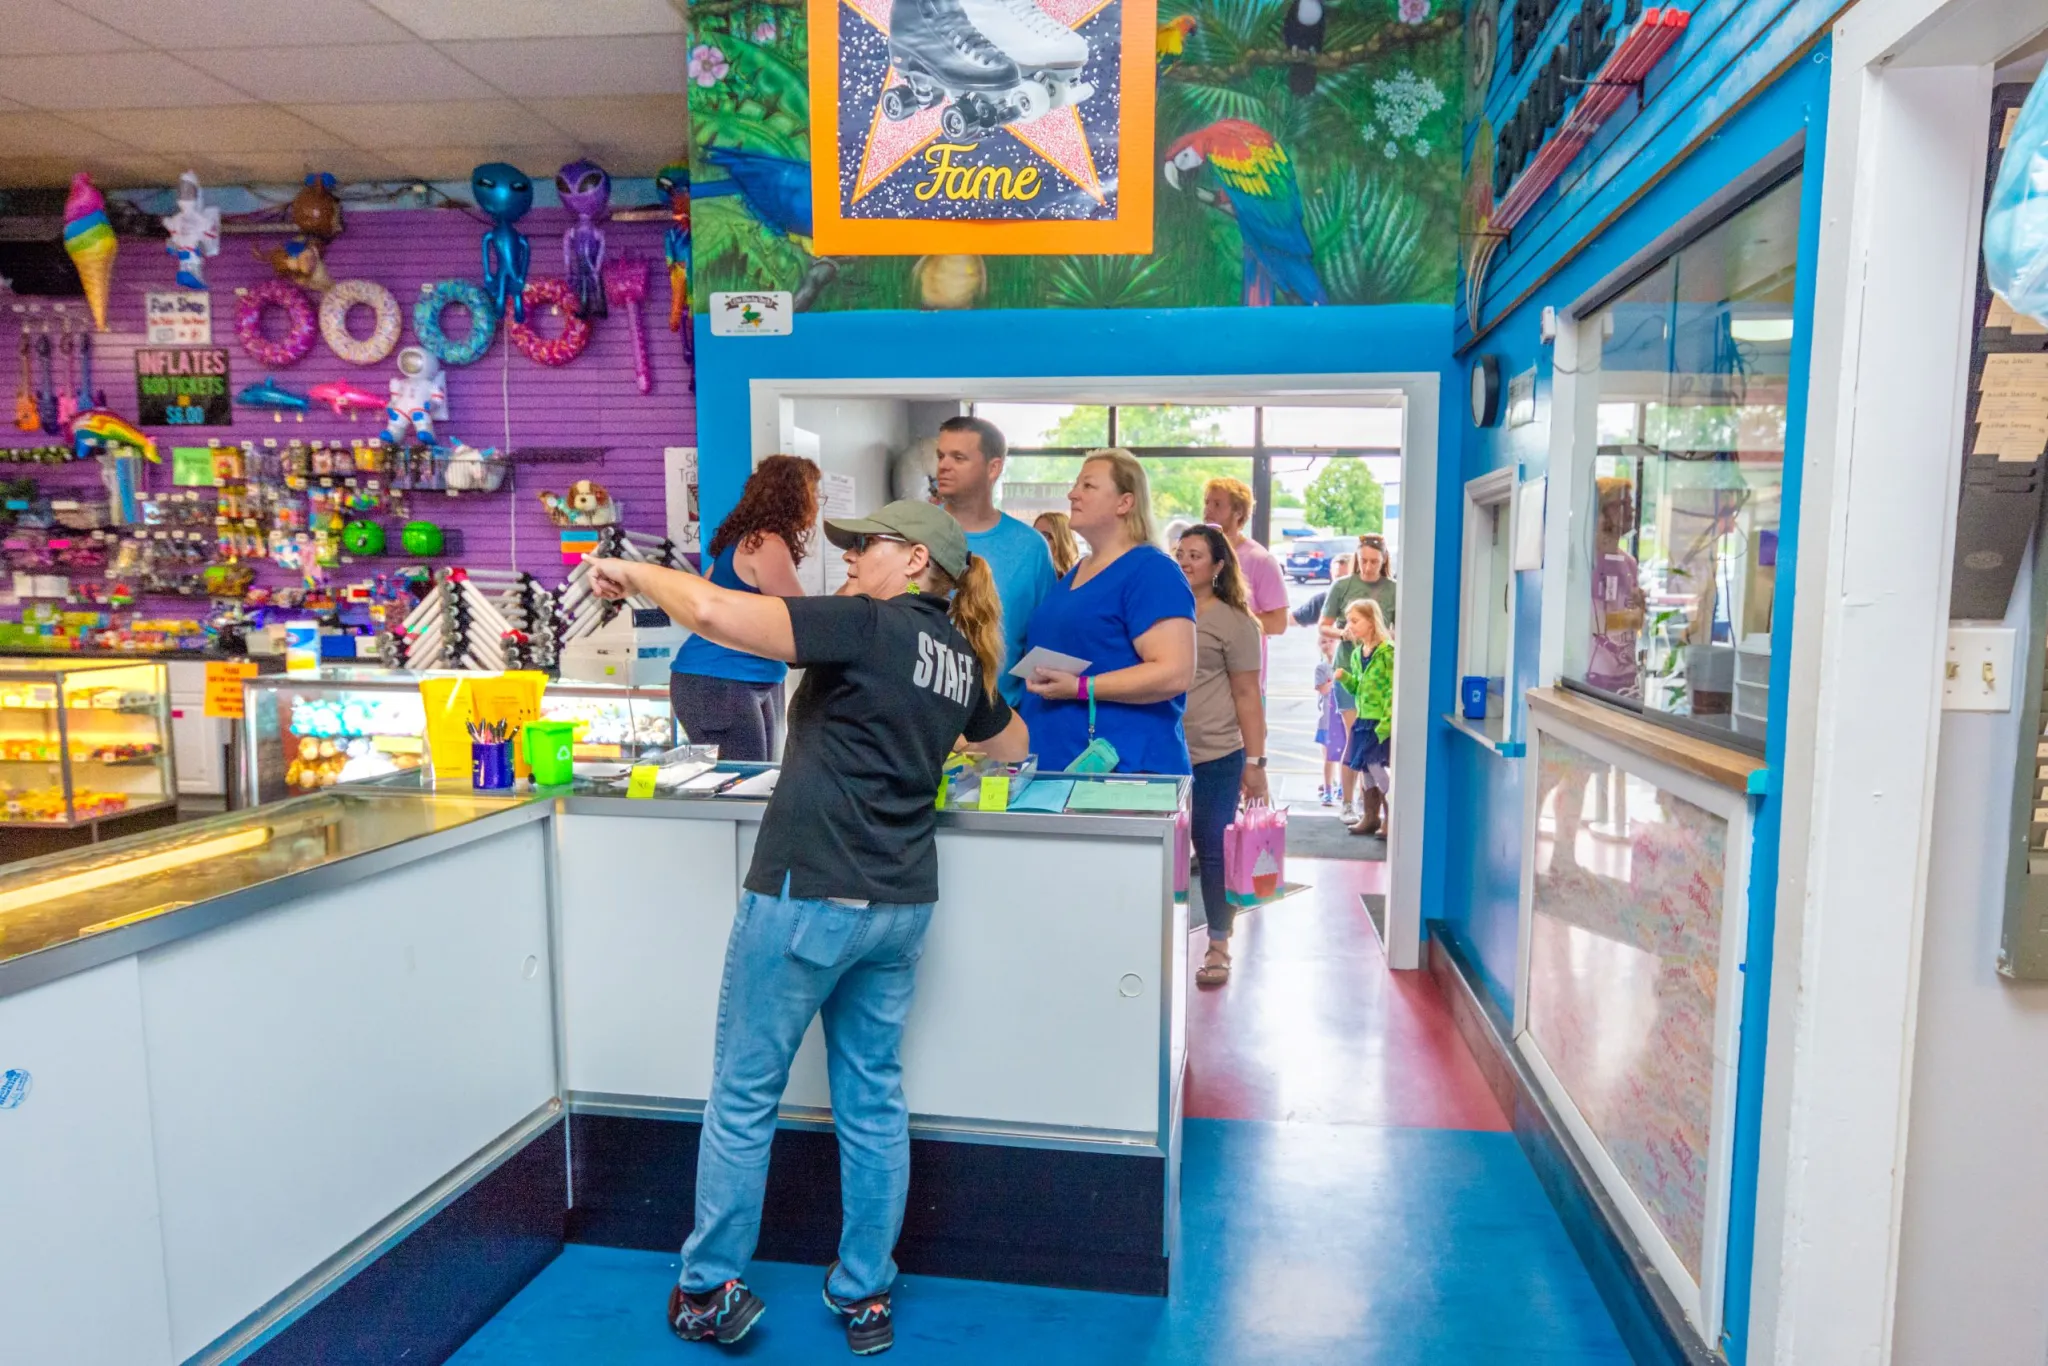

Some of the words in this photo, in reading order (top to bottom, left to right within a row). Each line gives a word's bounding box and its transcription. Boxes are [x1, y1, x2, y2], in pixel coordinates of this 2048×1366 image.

[914, 142, 1042, 201] Fame
[138, 351, 225, 374] INFLATES
[913, 631, 974, 708] STAFF
